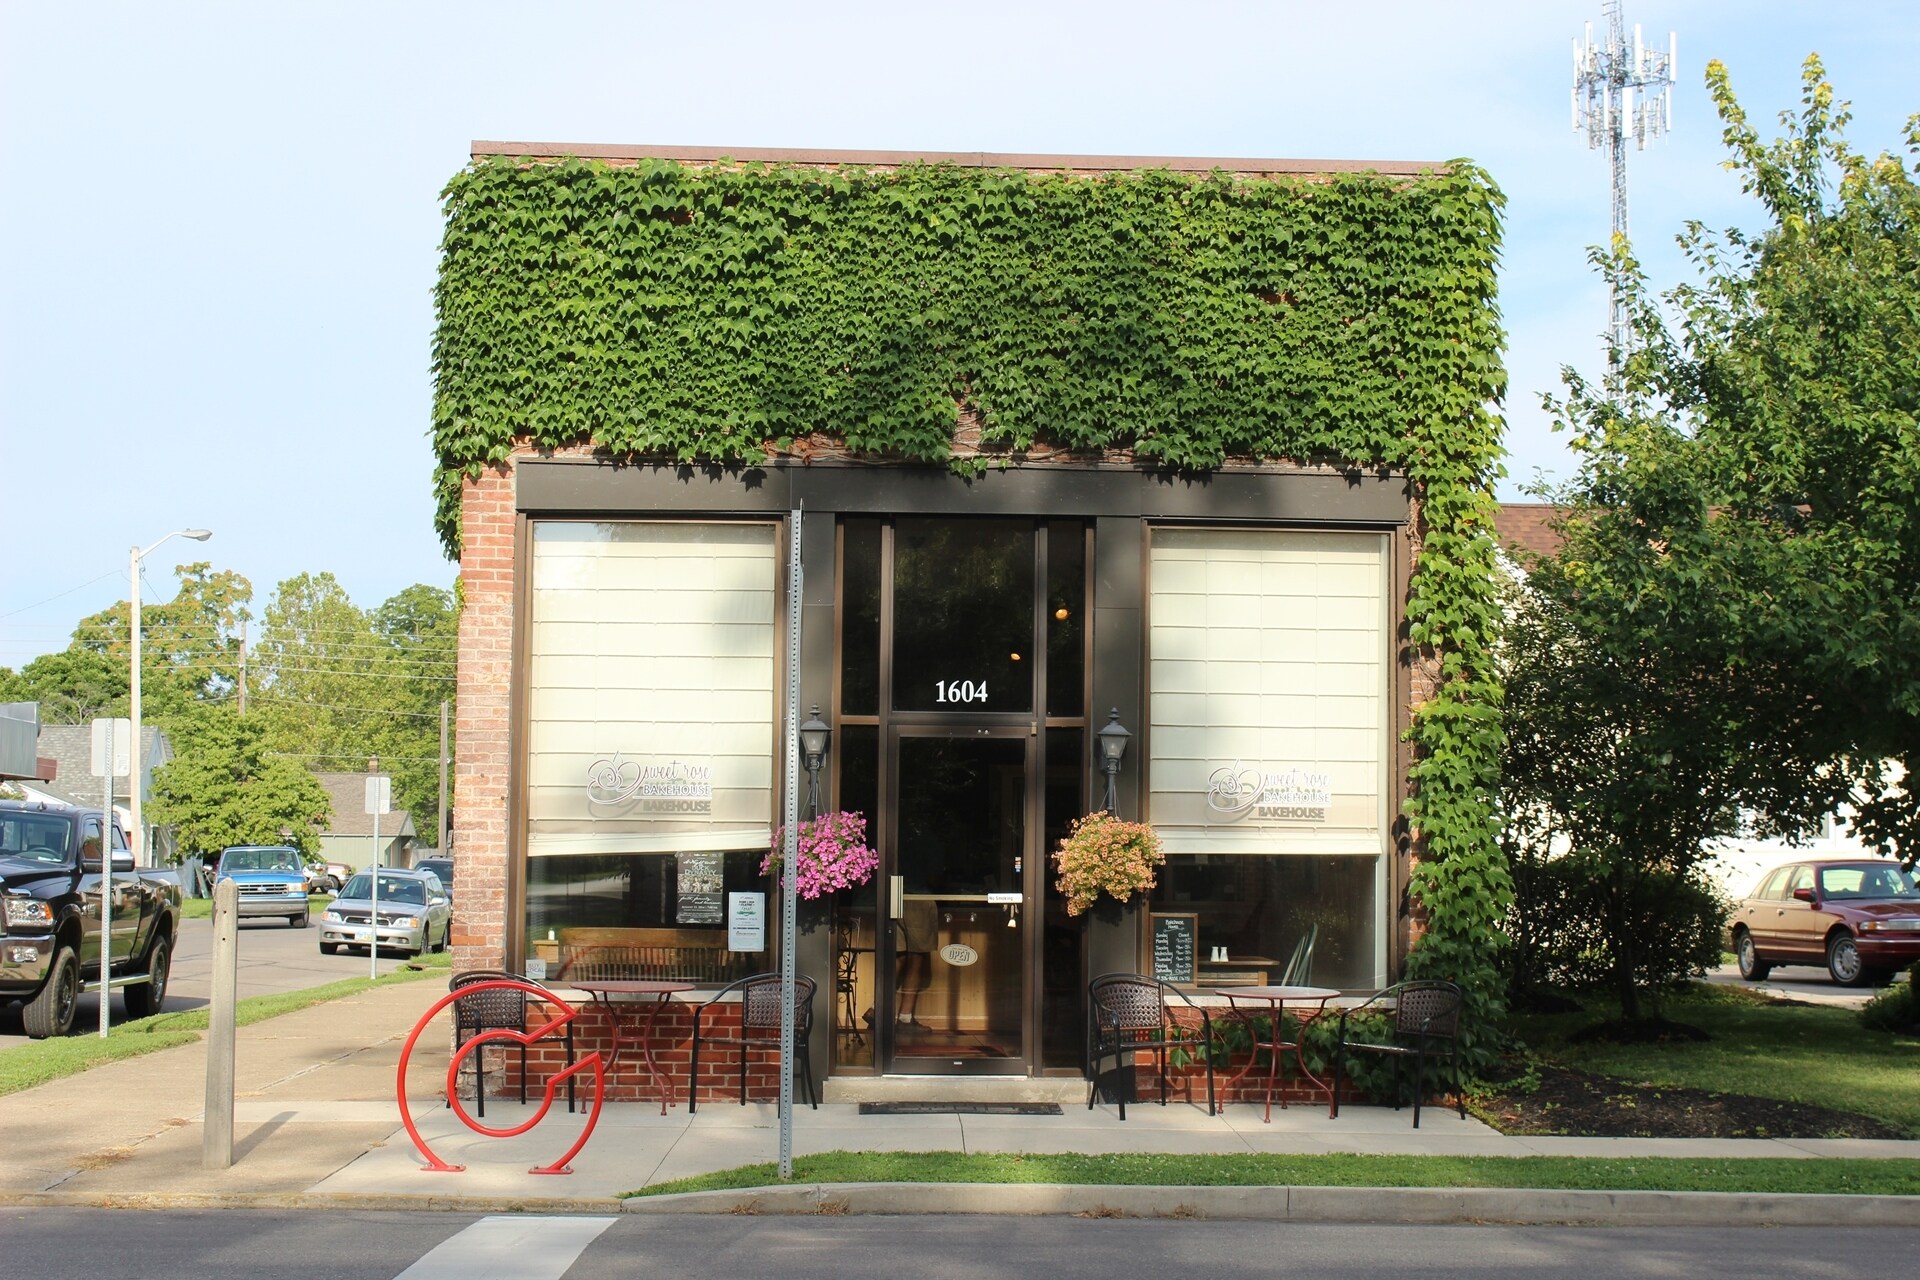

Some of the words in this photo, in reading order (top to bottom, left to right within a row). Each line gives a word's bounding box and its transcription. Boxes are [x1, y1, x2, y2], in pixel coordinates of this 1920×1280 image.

[935, 680, 988, 702] 1604
[643, 760, 681, 779] sweet
[683, 765, 710, 780] rose
[1265, 768, 1300, 787] sweet
[1304, 773, 1330, 787] rose
[643, 785, 711, 795] BAKEHOUSE
[1264, 792, 1330, 803] BAKEHOUSE
[643, 801, 711, 812] BAKEHOUSE
[1258, 807, 1325, 819] BAKEHOUSE
[949, 950, 970, 961] OPEN
